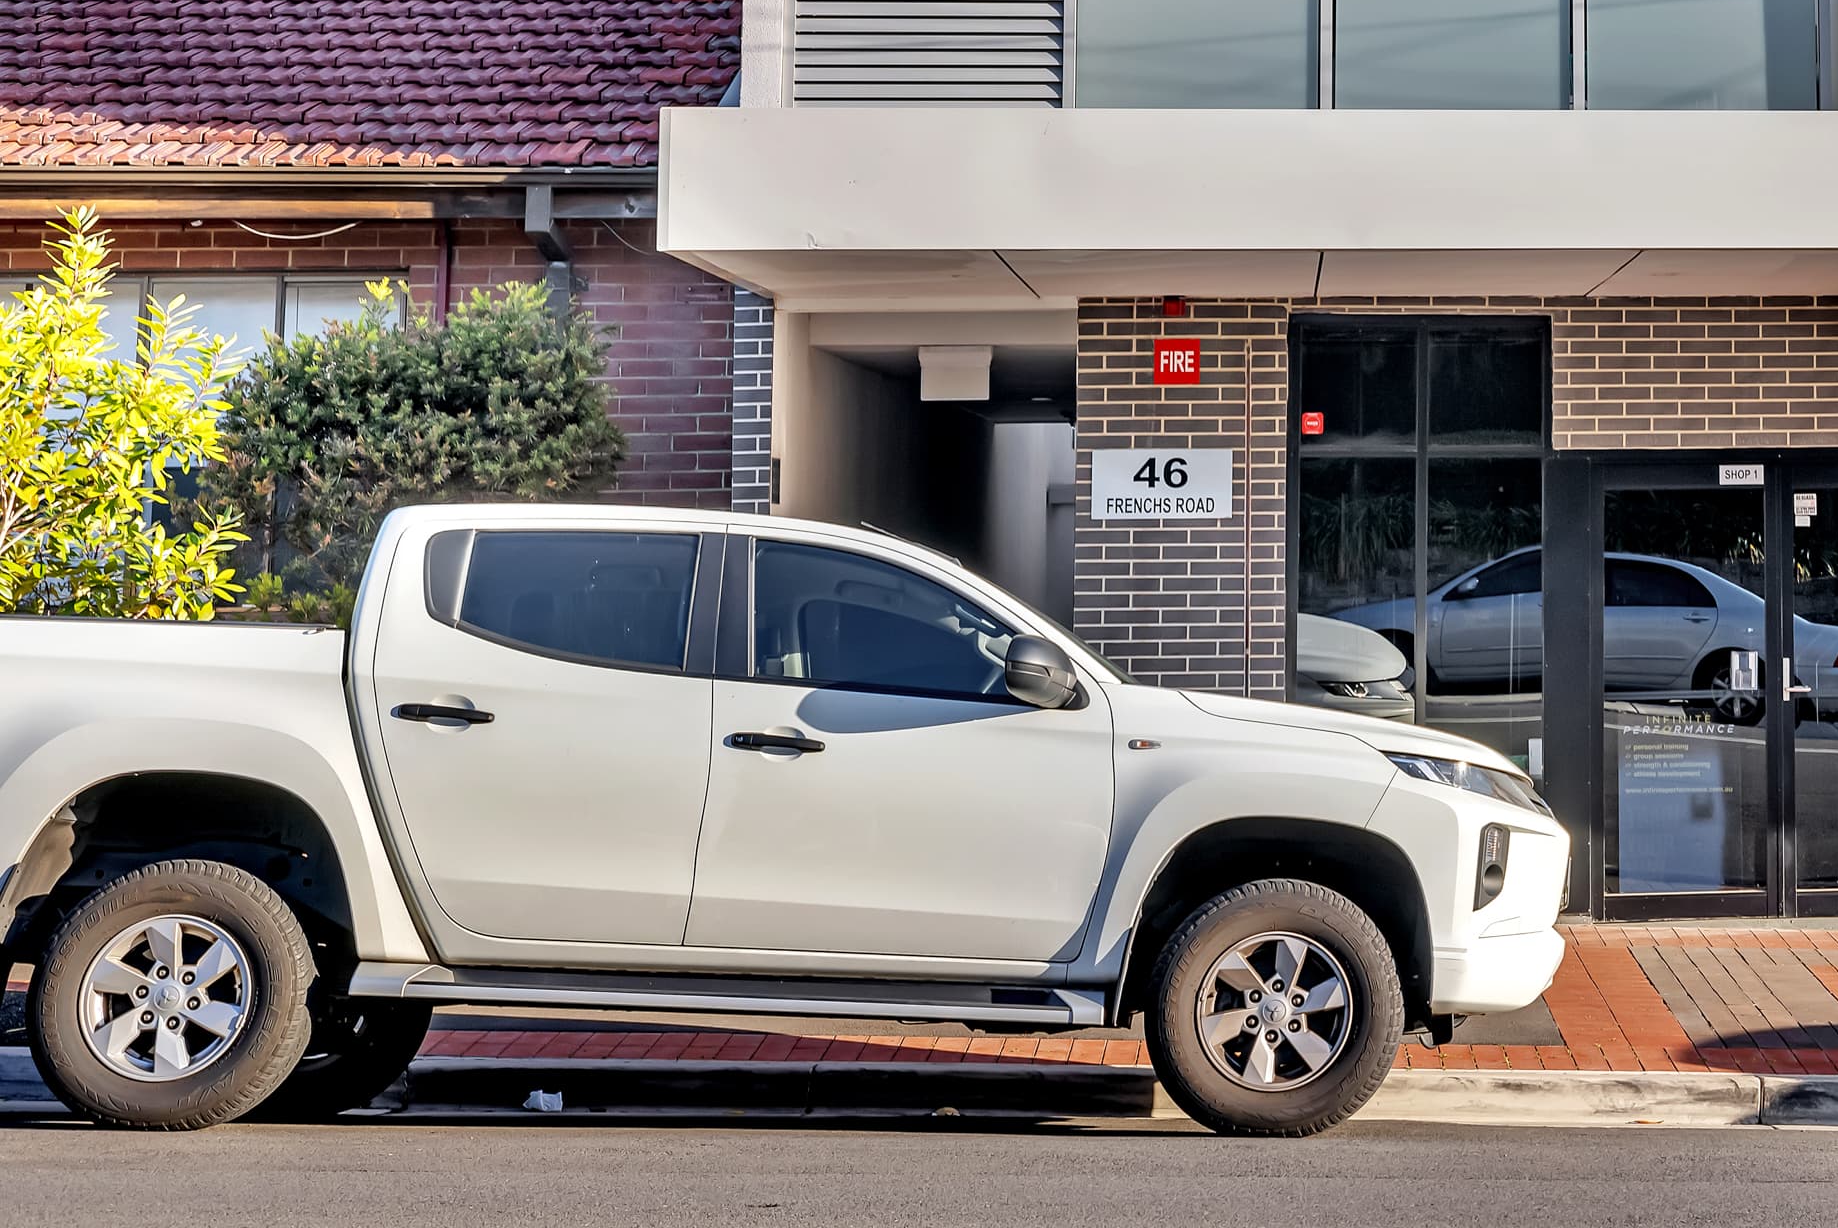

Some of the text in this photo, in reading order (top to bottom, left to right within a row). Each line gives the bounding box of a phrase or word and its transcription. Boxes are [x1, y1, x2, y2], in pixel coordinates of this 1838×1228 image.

[1160, 350, 1195, 373] FIRE
[1133, 457, 1189, 488] 46
[1724, 469, 1758, 480] SHOP 1
[1106, 497, 1215, 514] FRENCHS ROAD
[1646, 714, 1711, 725] INFINITE
[1623, 724, 1735, 735] PERFORMANCE
